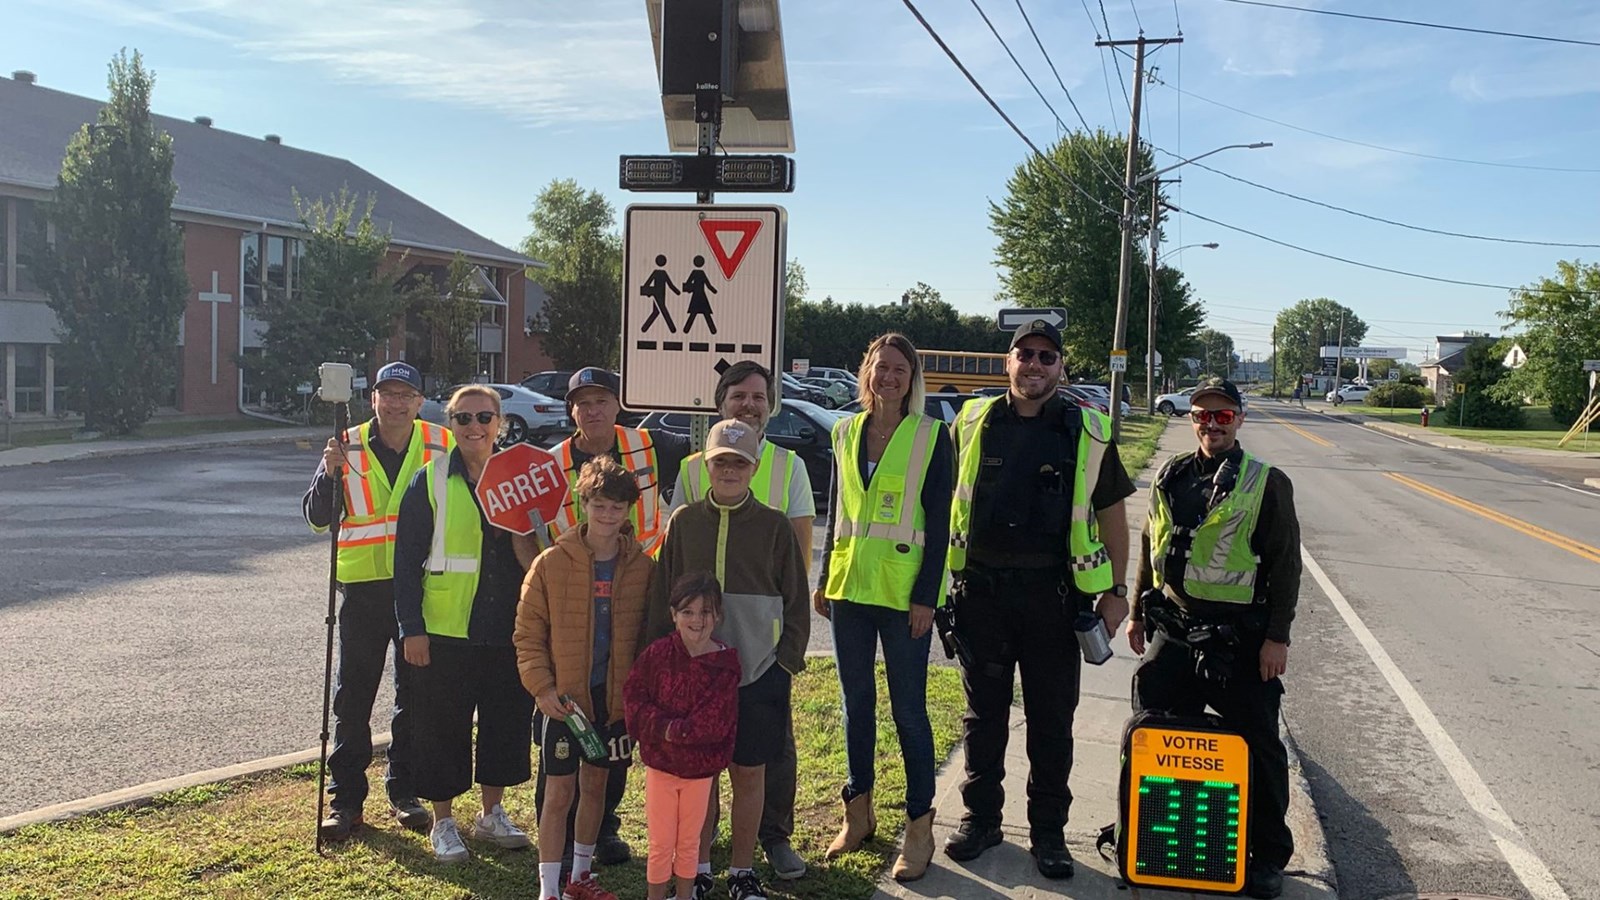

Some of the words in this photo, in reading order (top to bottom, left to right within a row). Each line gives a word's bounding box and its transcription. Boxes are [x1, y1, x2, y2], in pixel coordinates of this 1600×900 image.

[1390, 372, 1399, 380] 50
[486, 460, 559, 517] ARRÊT
[608, 734, 632, 761] 10
[1162, 735, 1218, 752] VOTRE
[1156, 754, 1224, 772] VITESSE
